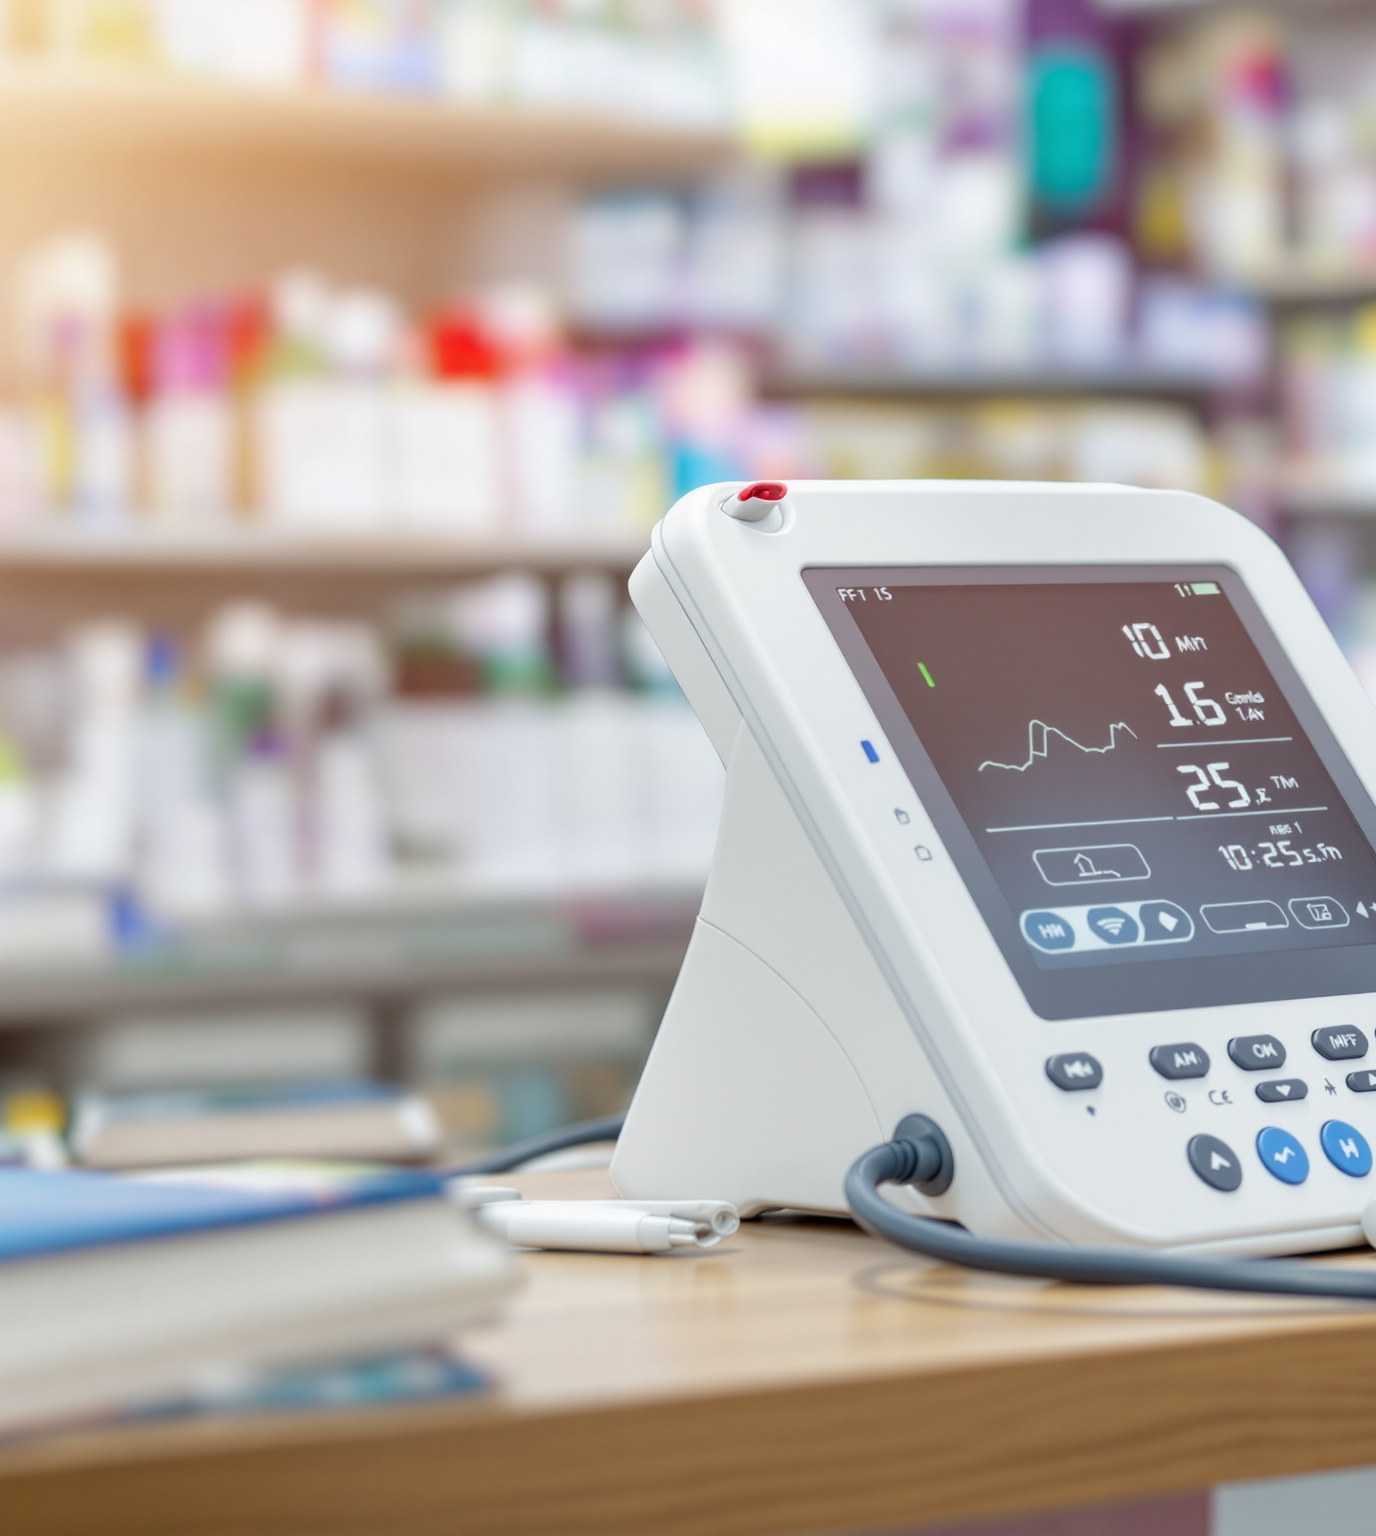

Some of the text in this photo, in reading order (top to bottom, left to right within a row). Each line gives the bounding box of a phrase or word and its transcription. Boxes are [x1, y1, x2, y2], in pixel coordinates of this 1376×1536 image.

[1122, 622, 1171, 660] 10
[1176, 762, 1251, 811] 25
[1218, 840, 1304, 871] 10:25
